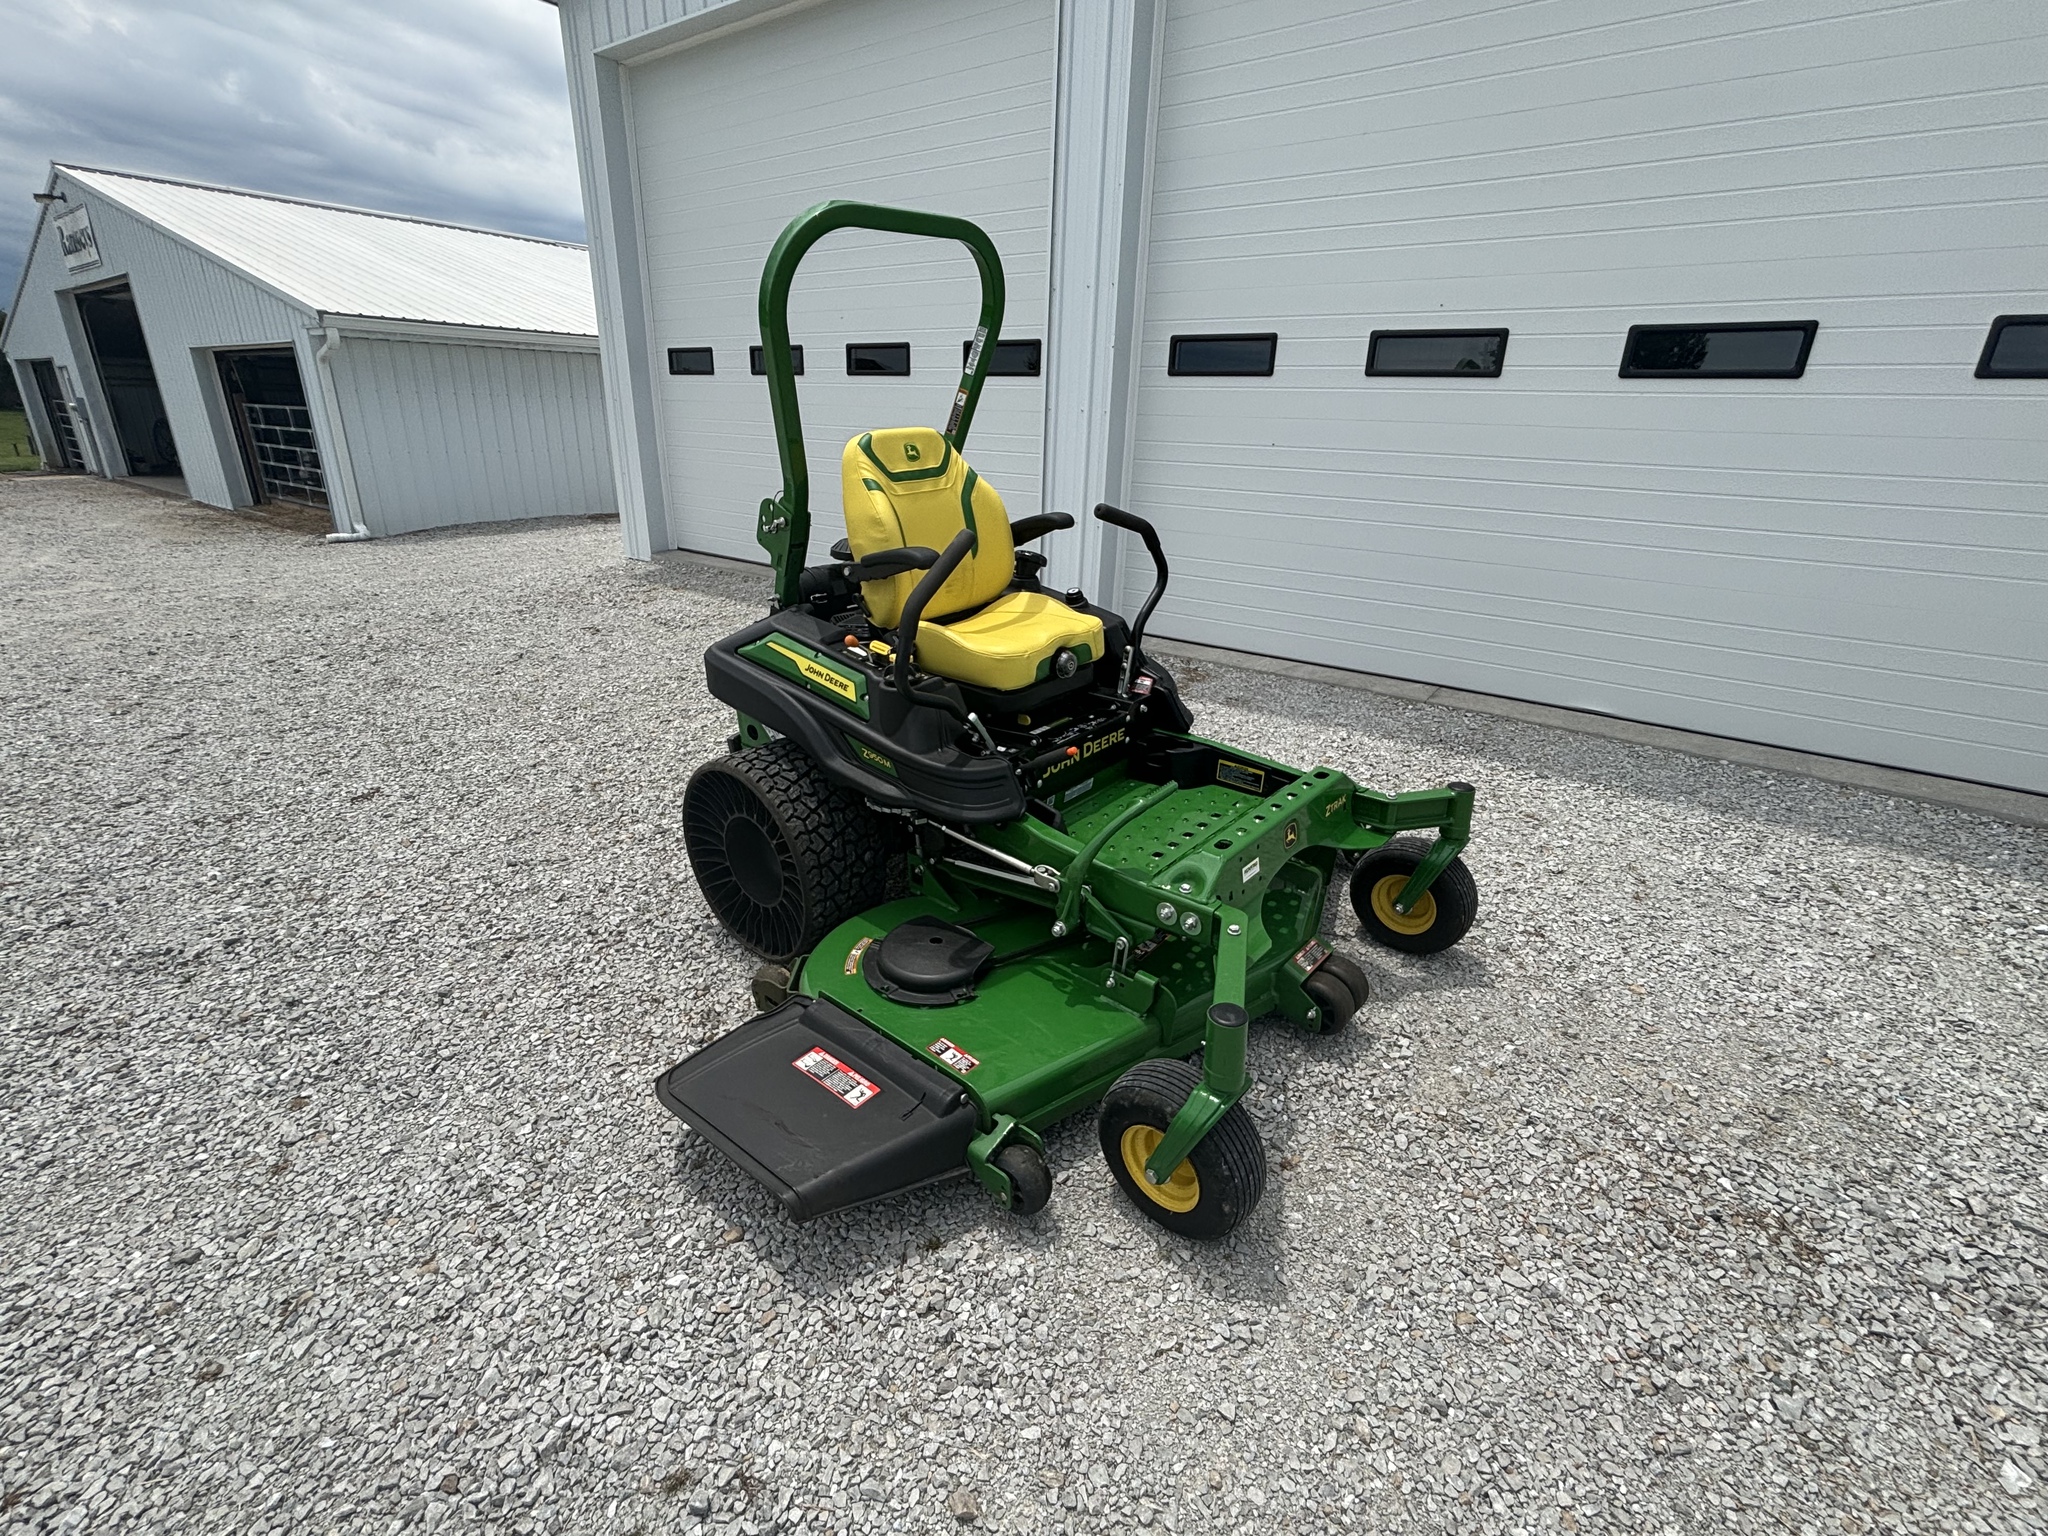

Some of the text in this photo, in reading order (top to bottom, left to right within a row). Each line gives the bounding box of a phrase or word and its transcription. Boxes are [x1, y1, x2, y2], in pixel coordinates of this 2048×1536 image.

[804, 664, 850, 691] JOHN DEERE
[1083, 727, 1126, 758] DEERE
